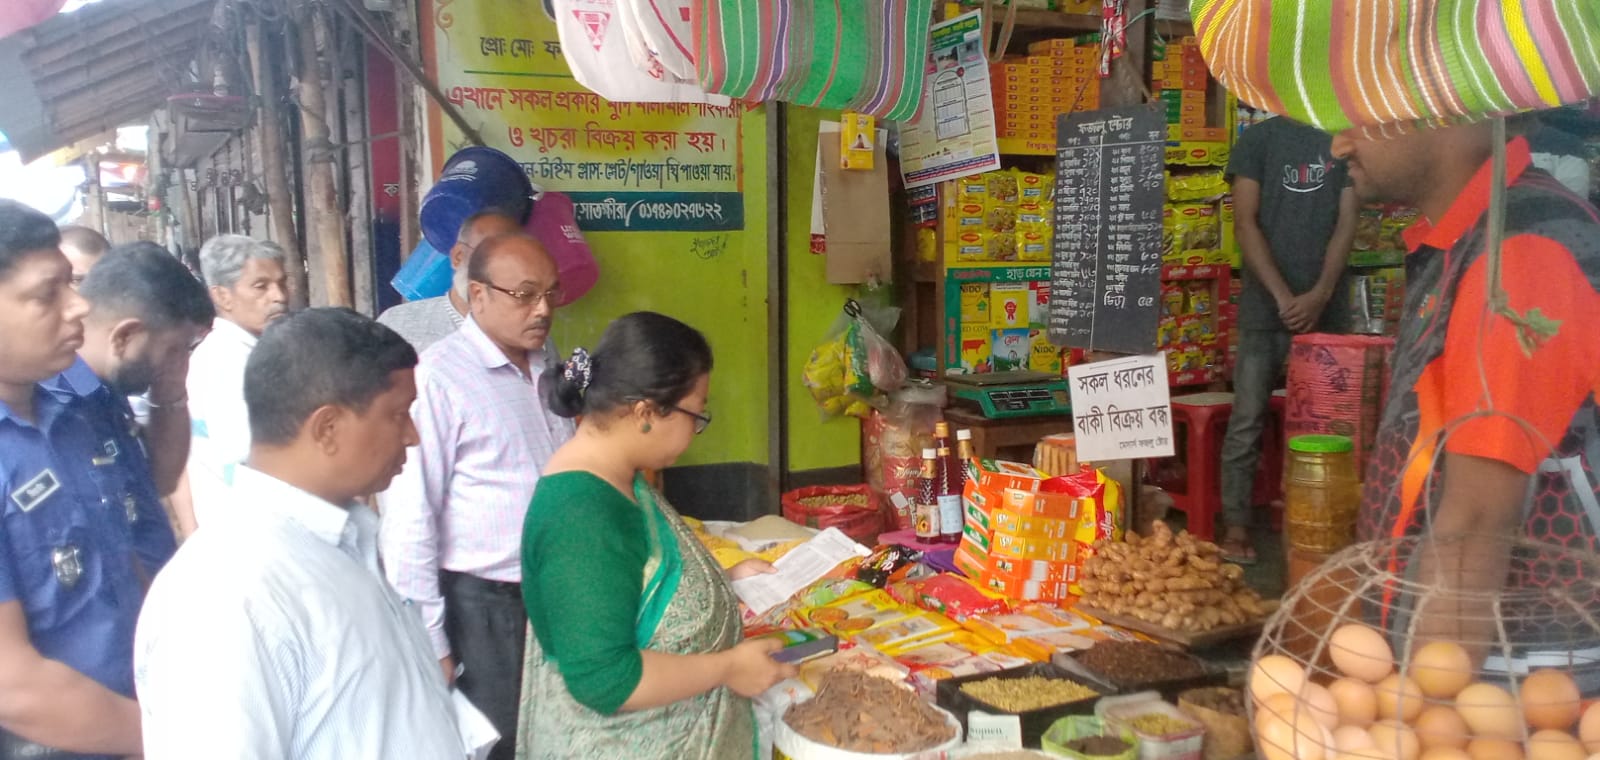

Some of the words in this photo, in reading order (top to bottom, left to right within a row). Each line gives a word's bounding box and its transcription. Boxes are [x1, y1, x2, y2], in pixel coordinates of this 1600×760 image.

[445, 86, 505, 110] এখানে
[508, 88, 553, 111] সকল
[555, 91, 601, 115] প্রকার
[508, 126, 524, 147] ও
[529, 127, 577, 153] খুচরা
[583, 120, 636, 151] বিক্রয়
[640, 131, 679, 151] করা
[520, 156, 576, 181] ন-টাইম
[680, 163, 711, 182] পাওয়া
[1043, 268, 1051, 277] ন
[1033, 344, 1056, 354] NIDO
[1076, 372, 1109, 395] সকল
[1114, 365, 1154, 391] ধরনের
[1076, 404, 1105, 436] বাকী
[1107, 403, 1144, 433] বিক্রয়
[1146, 405, 1168, 427] বন্ধ
